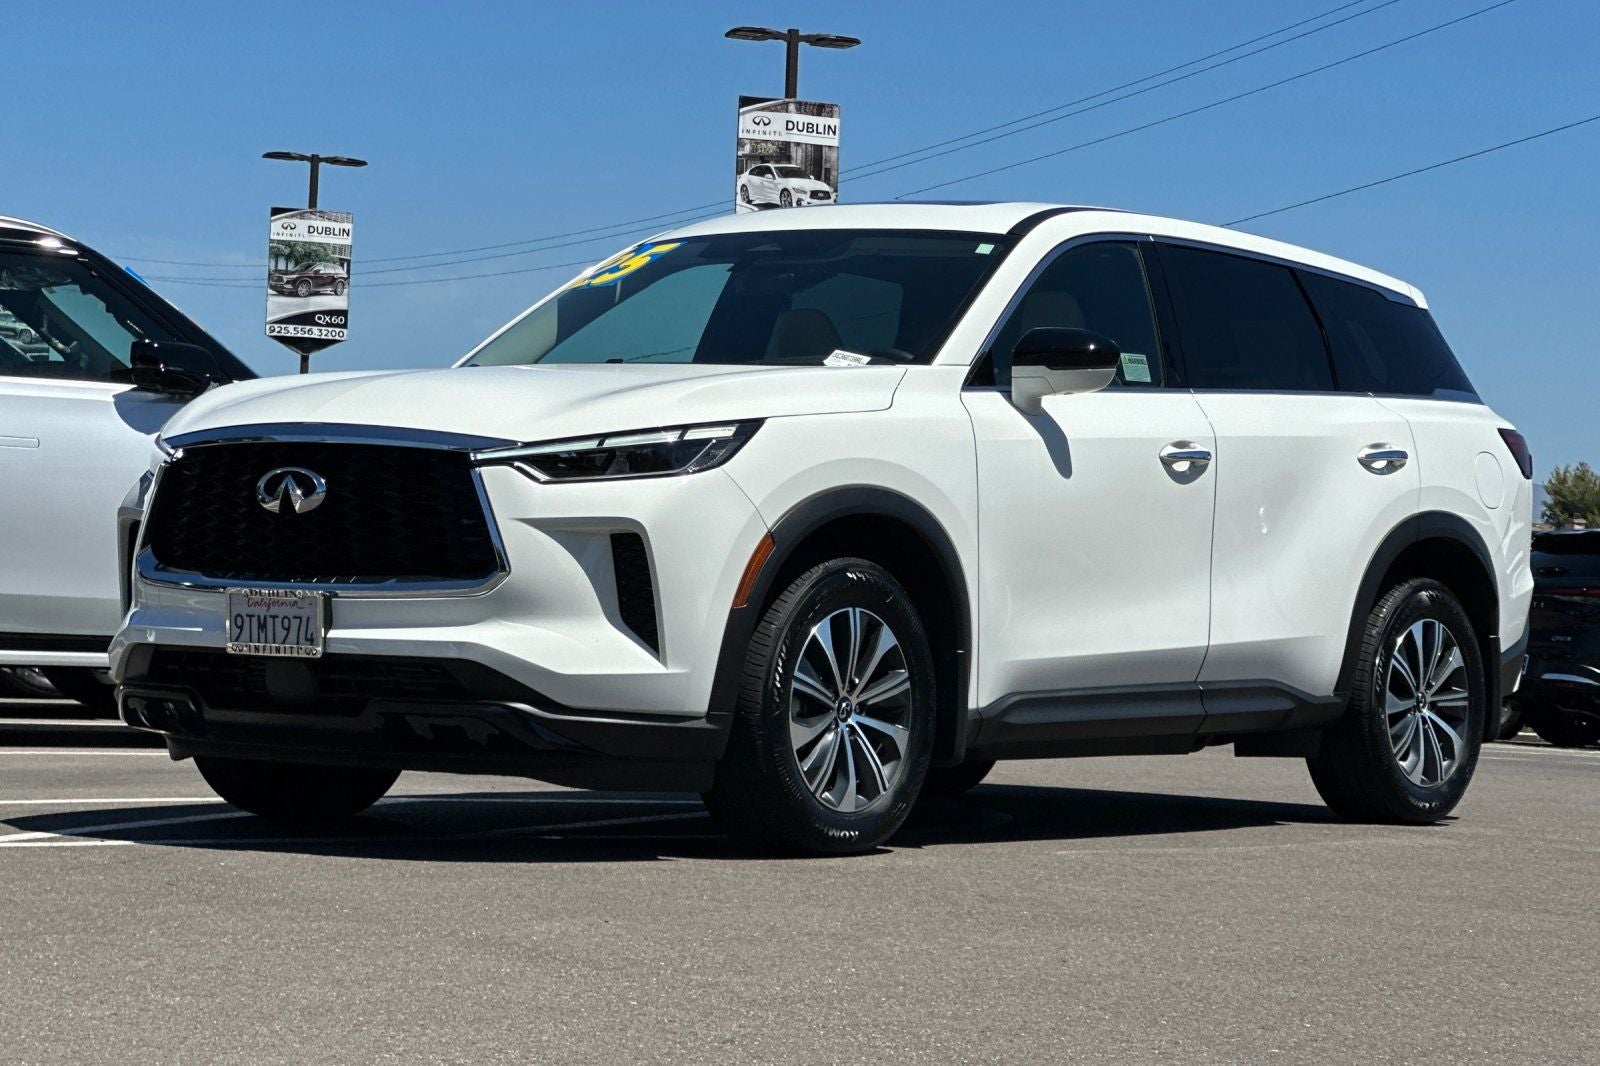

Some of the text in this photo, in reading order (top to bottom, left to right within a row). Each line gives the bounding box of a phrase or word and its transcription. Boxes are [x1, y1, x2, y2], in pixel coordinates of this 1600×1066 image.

[741, 128, 783, 137] INFINITI
[785, 119, 837, 136] DUBLIN
[307, 225, 350, 237] DUBLIN
[314, 314, 345, 325] QX60
[268, 325, 345, 339] 925.556.3200
[249, 588, 298, 598] DUBLIN
[247, 598, 305, 612] California
[234, 613, 315, 646] 9TMT974
[248, 644, 301, 655] INFINITI
